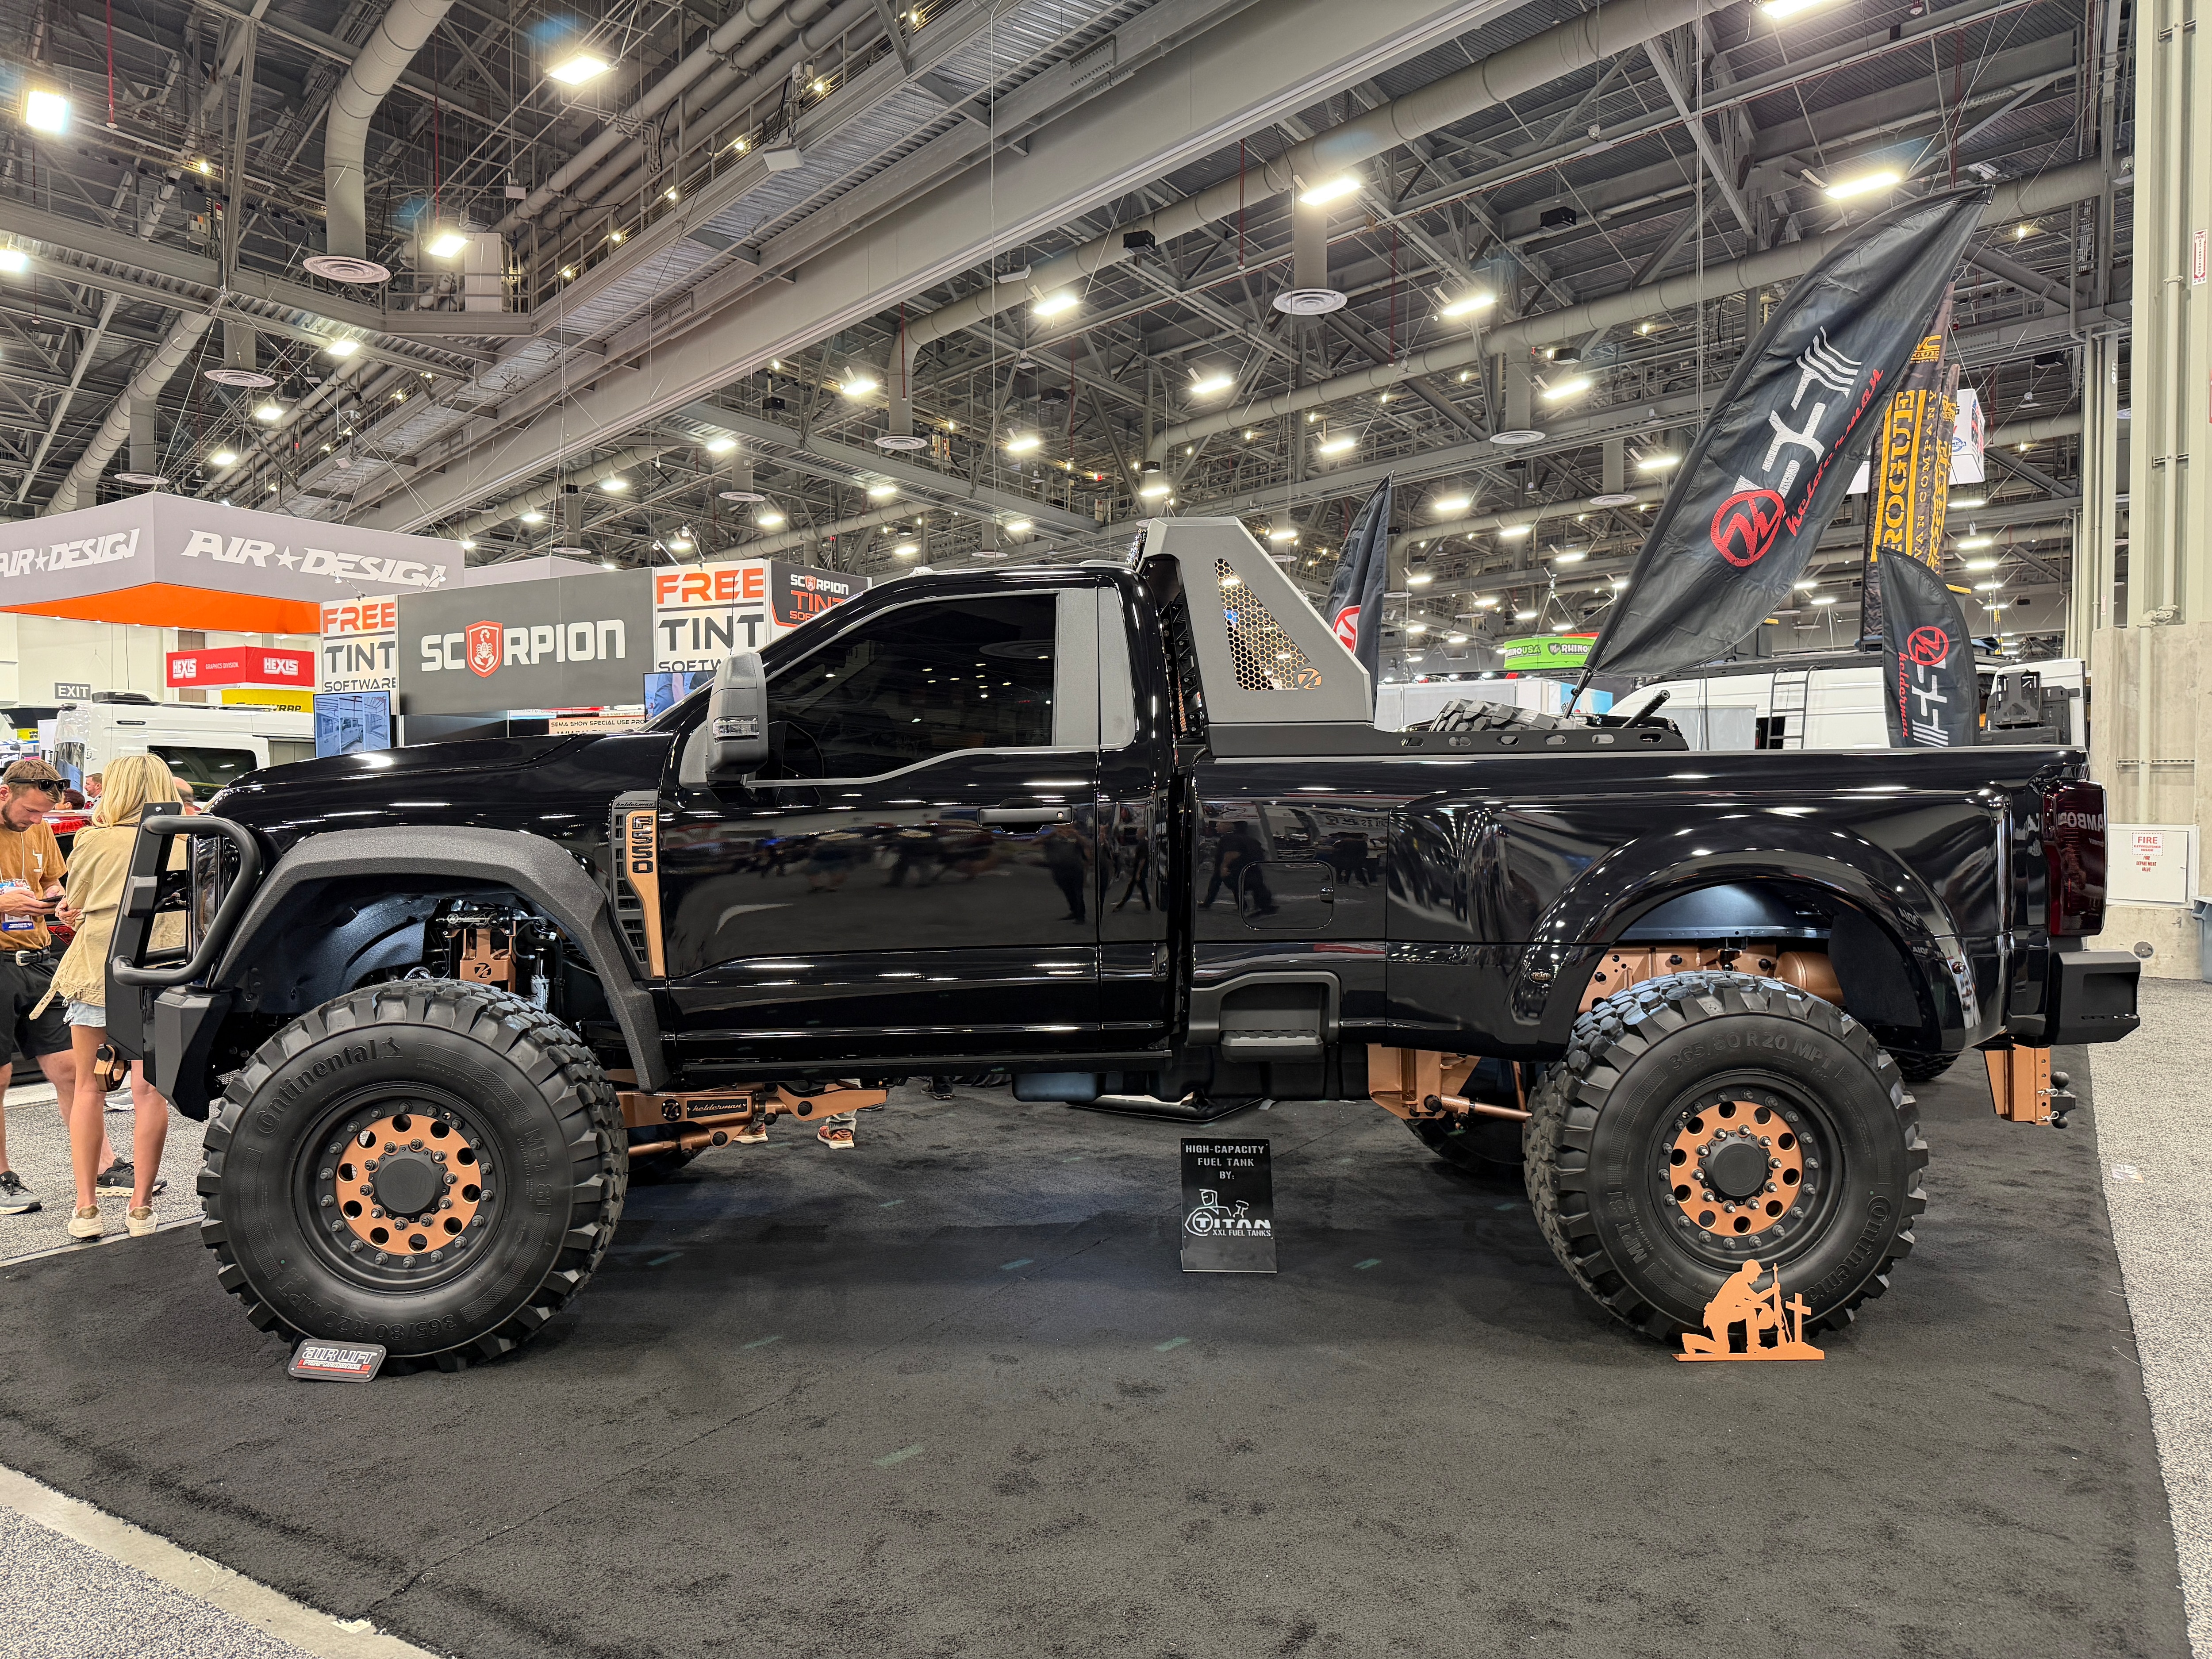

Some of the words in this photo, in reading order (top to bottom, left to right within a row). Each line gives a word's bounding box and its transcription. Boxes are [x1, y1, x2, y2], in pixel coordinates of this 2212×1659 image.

[181, 530, 275, 567] AIR
[657, 568, 764, 604] FREE
[323, 602, 395, 633] FREE
[658, 614, 764, 651] TINT
[324, 641, 395, 672] TINT
[173, 658, 197, 679] HEXIS
[264, 658, 299, 676] HEXIS
[58, 685, 89, 698] EXIT
[1186, 1145, 1264, 1154] HIGH-CAPACITY
[1198, 1158, 1222, 1166] FUEL
[1226, 1158, 1254, 1167] TANK
[1219, 1171, 1235, 1179] BY:
[1192, 1212, 1271, 1232] TITAN
